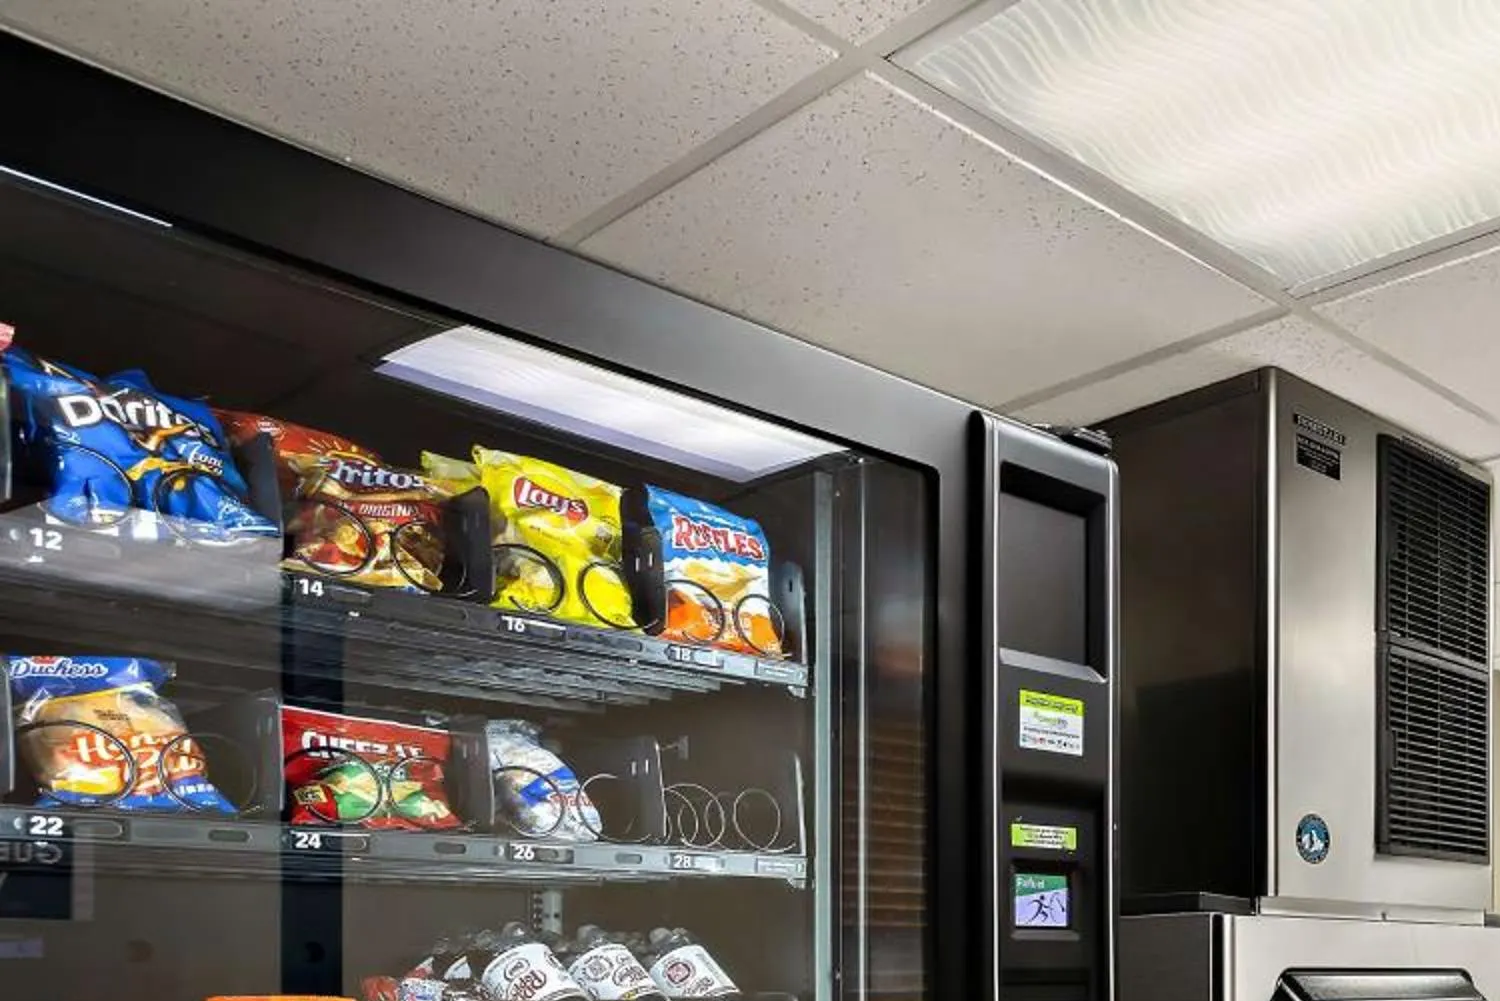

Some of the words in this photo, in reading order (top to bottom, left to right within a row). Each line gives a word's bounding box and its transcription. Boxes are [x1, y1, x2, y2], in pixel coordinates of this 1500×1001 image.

[29, 527, 63, 551] 12
[672, 514, 766, 560] RUFFLES
[299, 578, 325, 597] 14
[505, 617, 526, 633] 16
[10, 656, 108, 678] Duchess
[29, 815, 64, 836] 22
[294, 832, 322, 850] 24
[513, 844, 536, 862] 26
[673, 854, 693, 870] 28
